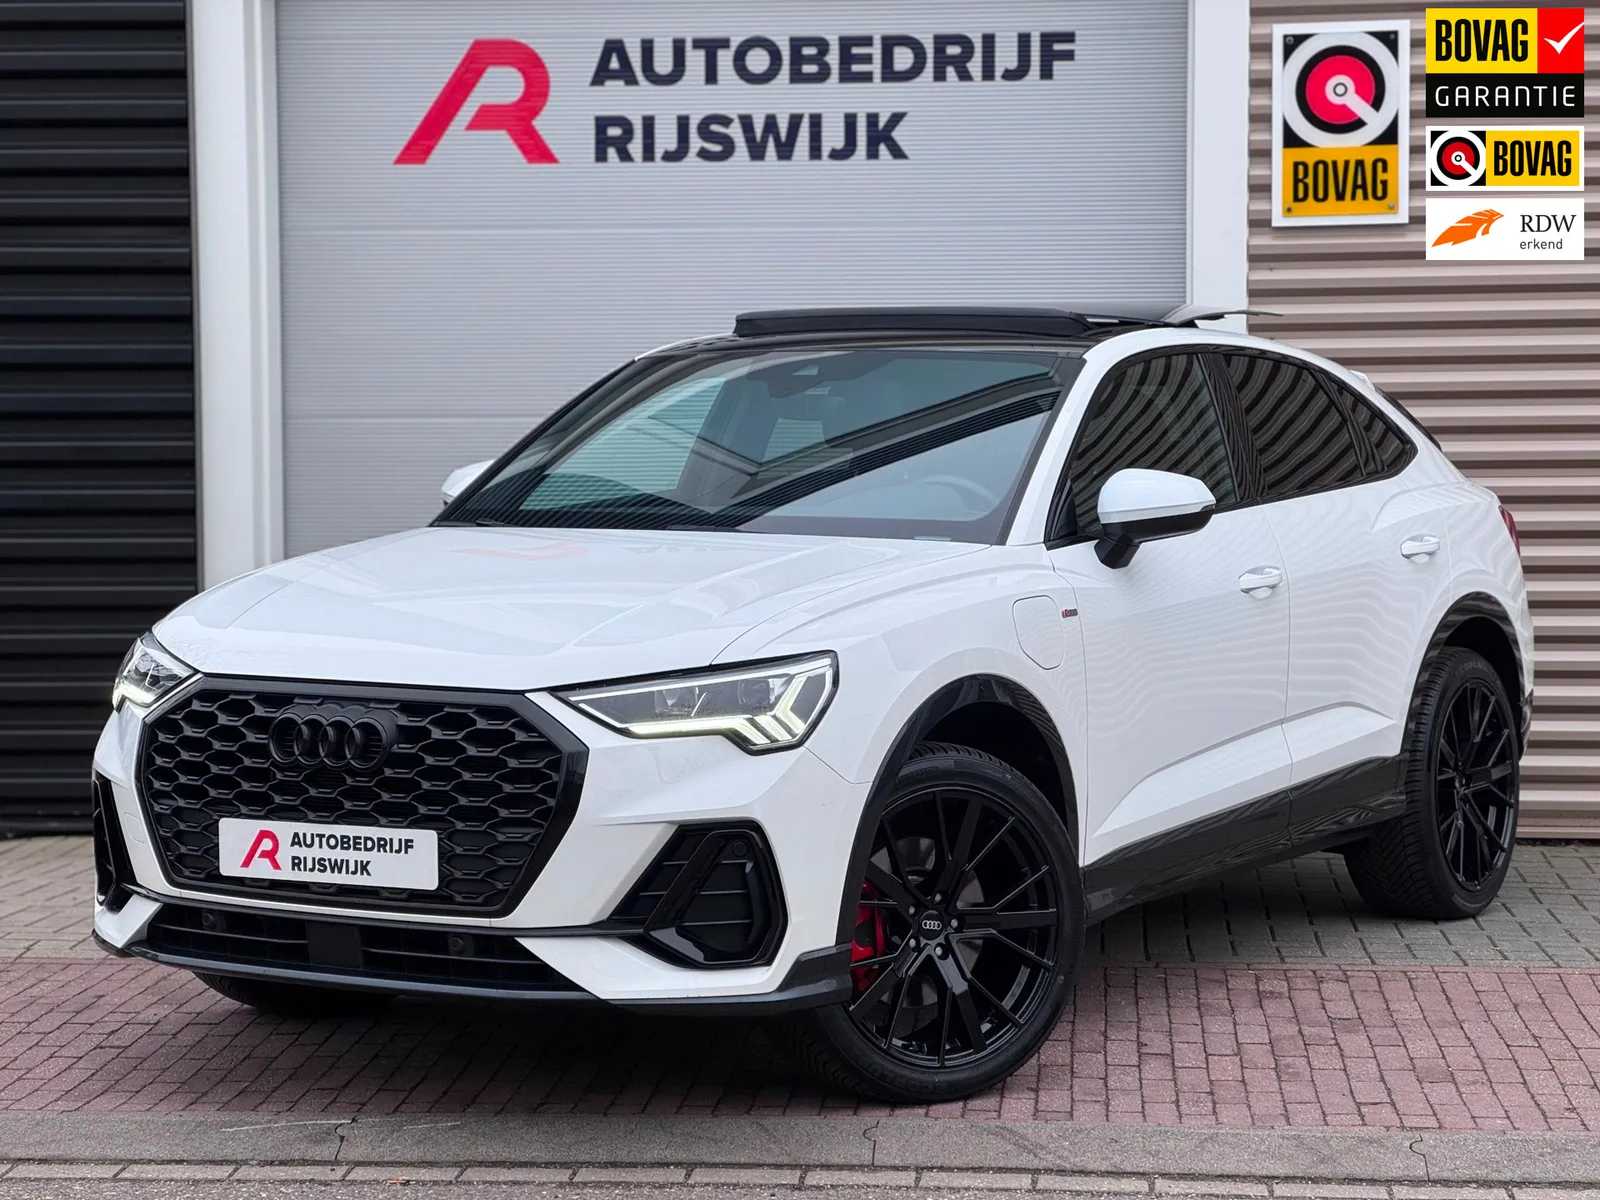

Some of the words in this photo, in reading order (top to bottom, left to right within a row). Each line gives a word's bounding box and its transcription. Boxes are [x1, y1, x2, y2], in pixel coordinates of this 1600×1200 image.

[590, 31, 1076, 87] AUTOBEDRIJF
[594, 111, 909, 163] RIJSWIJK
[1292, 157, 1389, 203] BOVAG
[290, 831, 415, 855] AUTOBEDRIJF
[291, 855, 373, 877] RIJSWIJK
